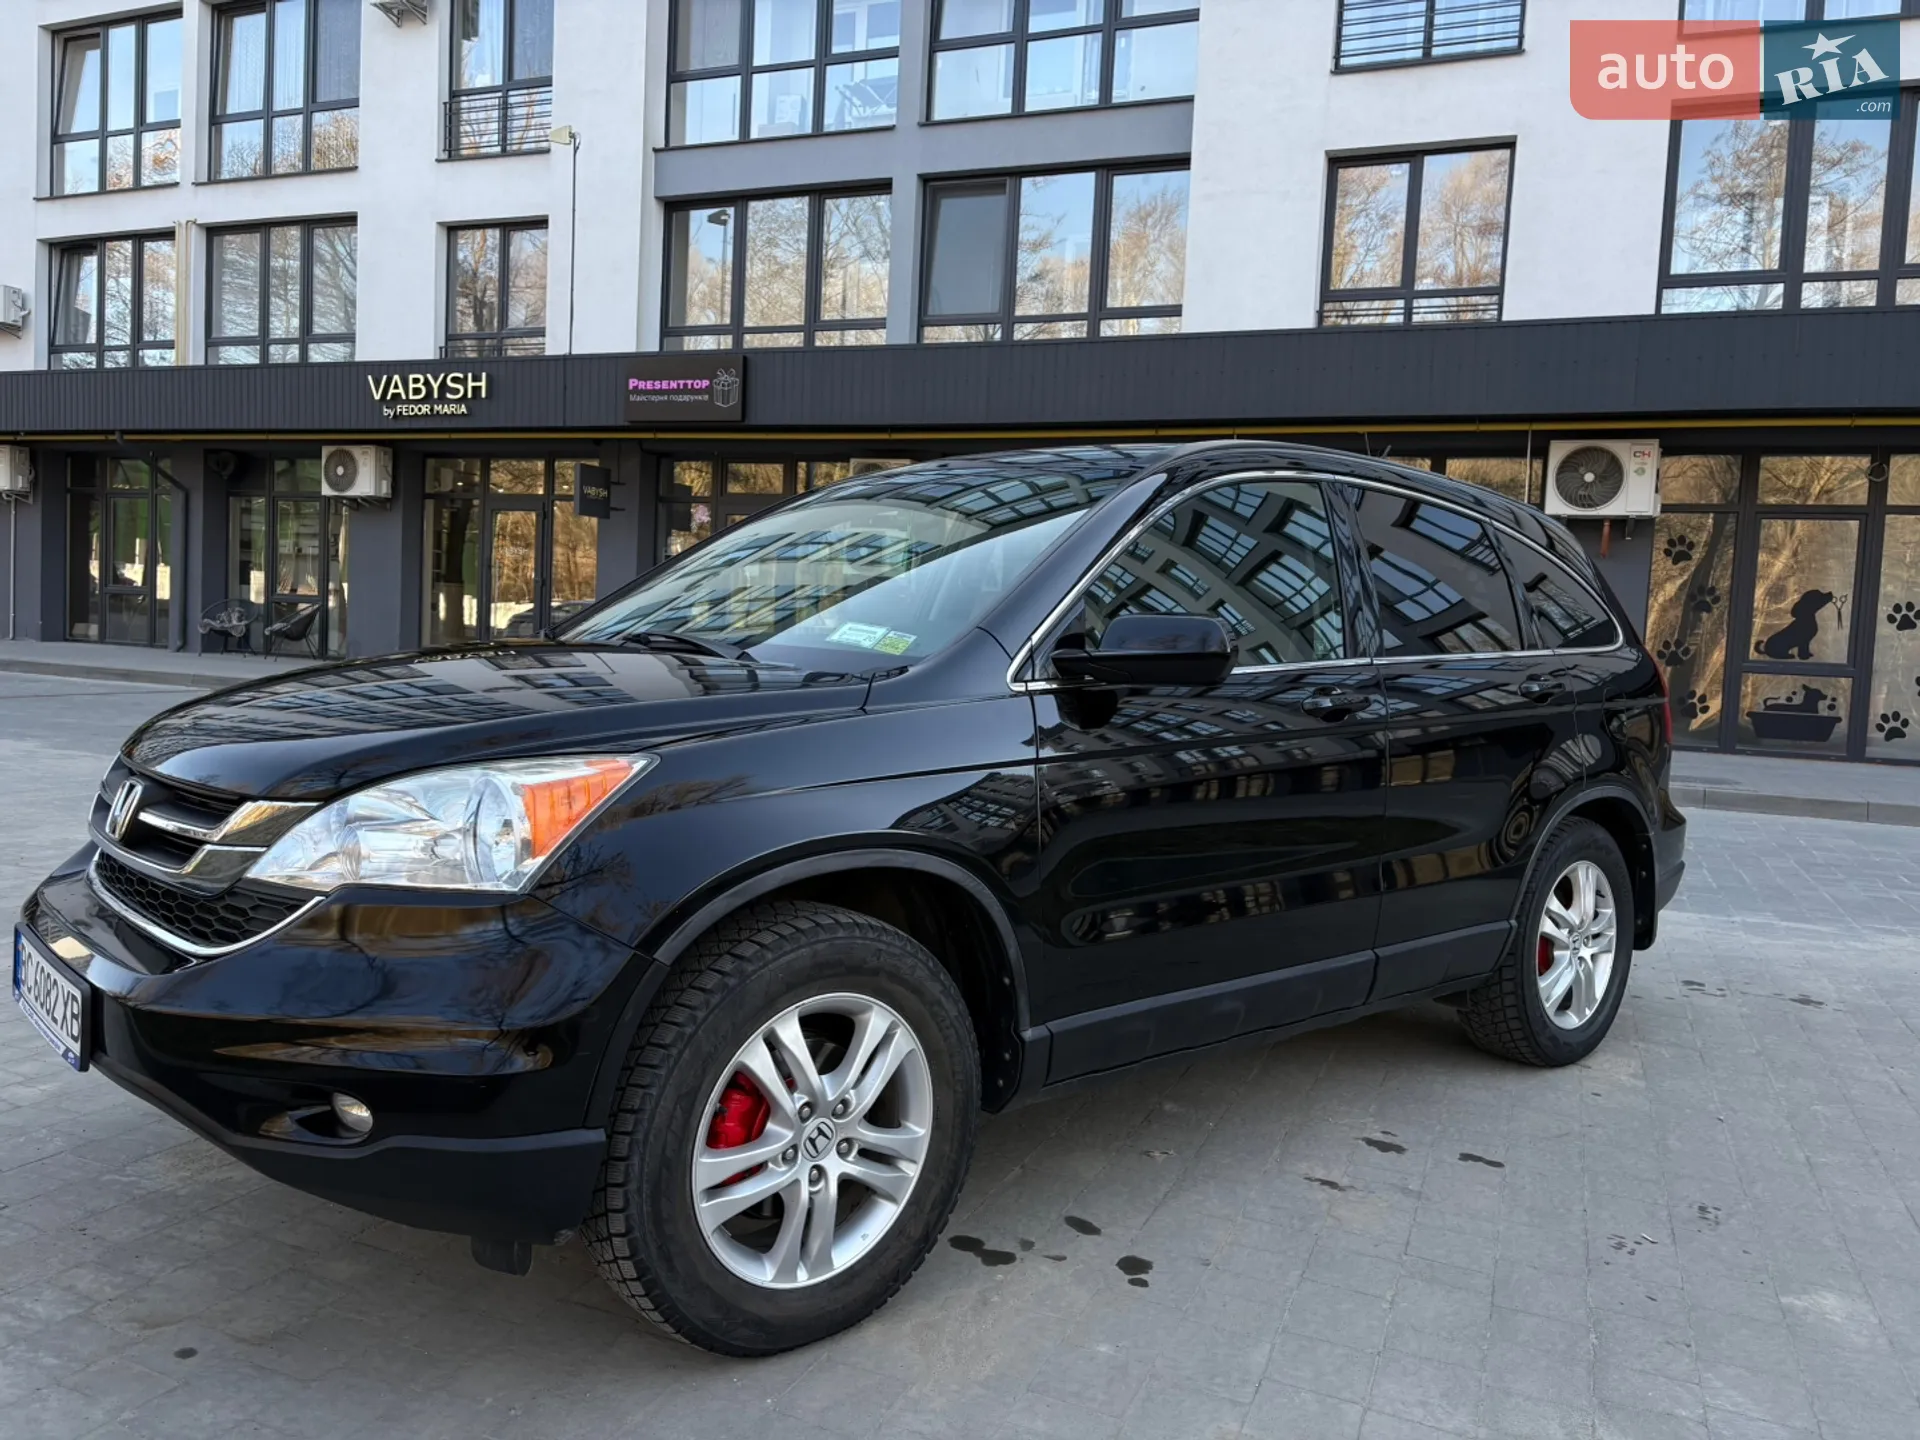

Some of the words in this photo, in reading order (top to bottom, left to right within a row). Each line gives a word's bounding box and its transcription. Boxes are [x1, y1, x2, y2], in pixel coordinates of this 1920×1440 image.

[367, 371, 487, 400] VABYSH
[382, 405, 395, 419] by
[396, 404, 431, 416] FEDOR
[433, 403, 468, 415] MARIA
